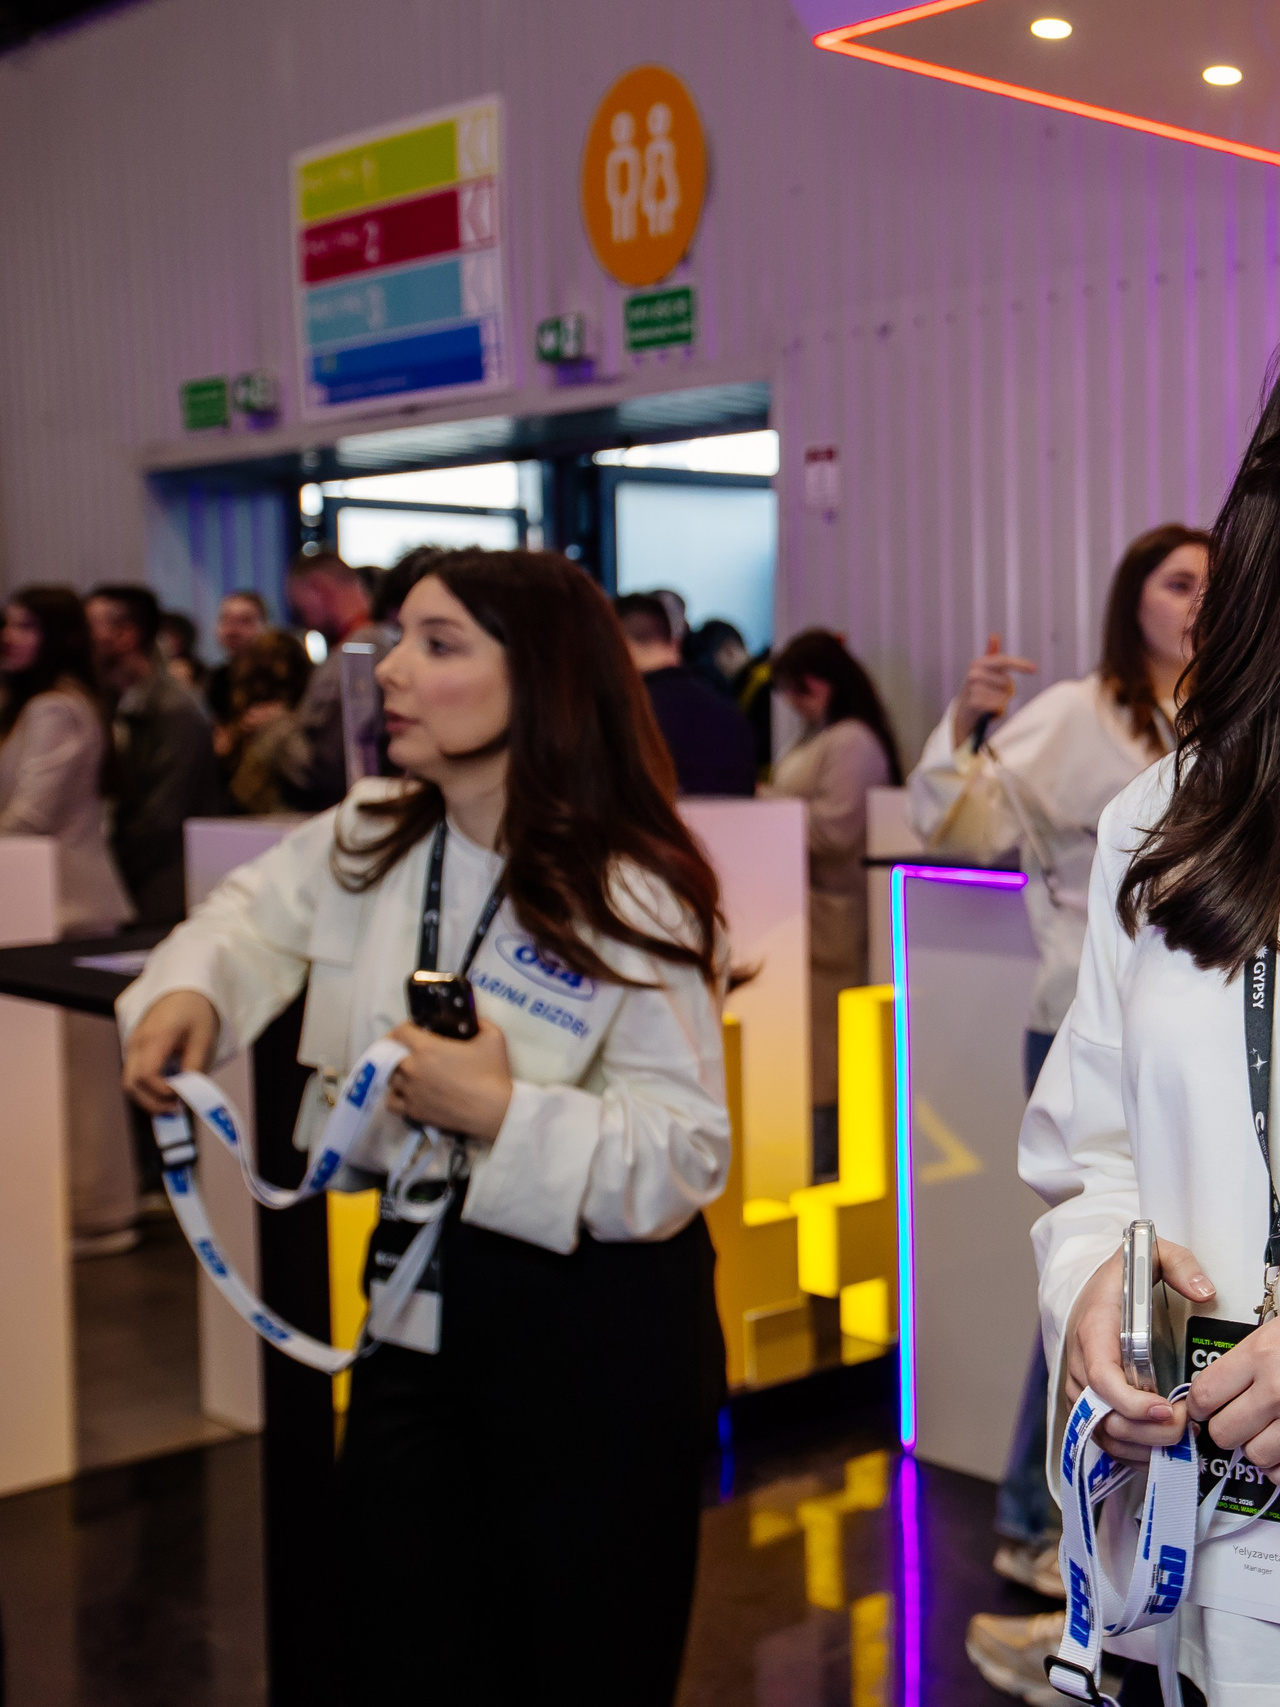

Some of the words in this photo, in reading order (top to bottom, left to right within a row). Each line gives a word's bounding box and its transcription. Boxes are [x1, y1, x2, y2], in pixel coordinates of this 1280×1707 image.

[1252, 961, 1267, 1010] GYPSY
[1213, 1340, 1237, 1349] VERTIC
[1244, 1563, 1273, 1576] Manager
